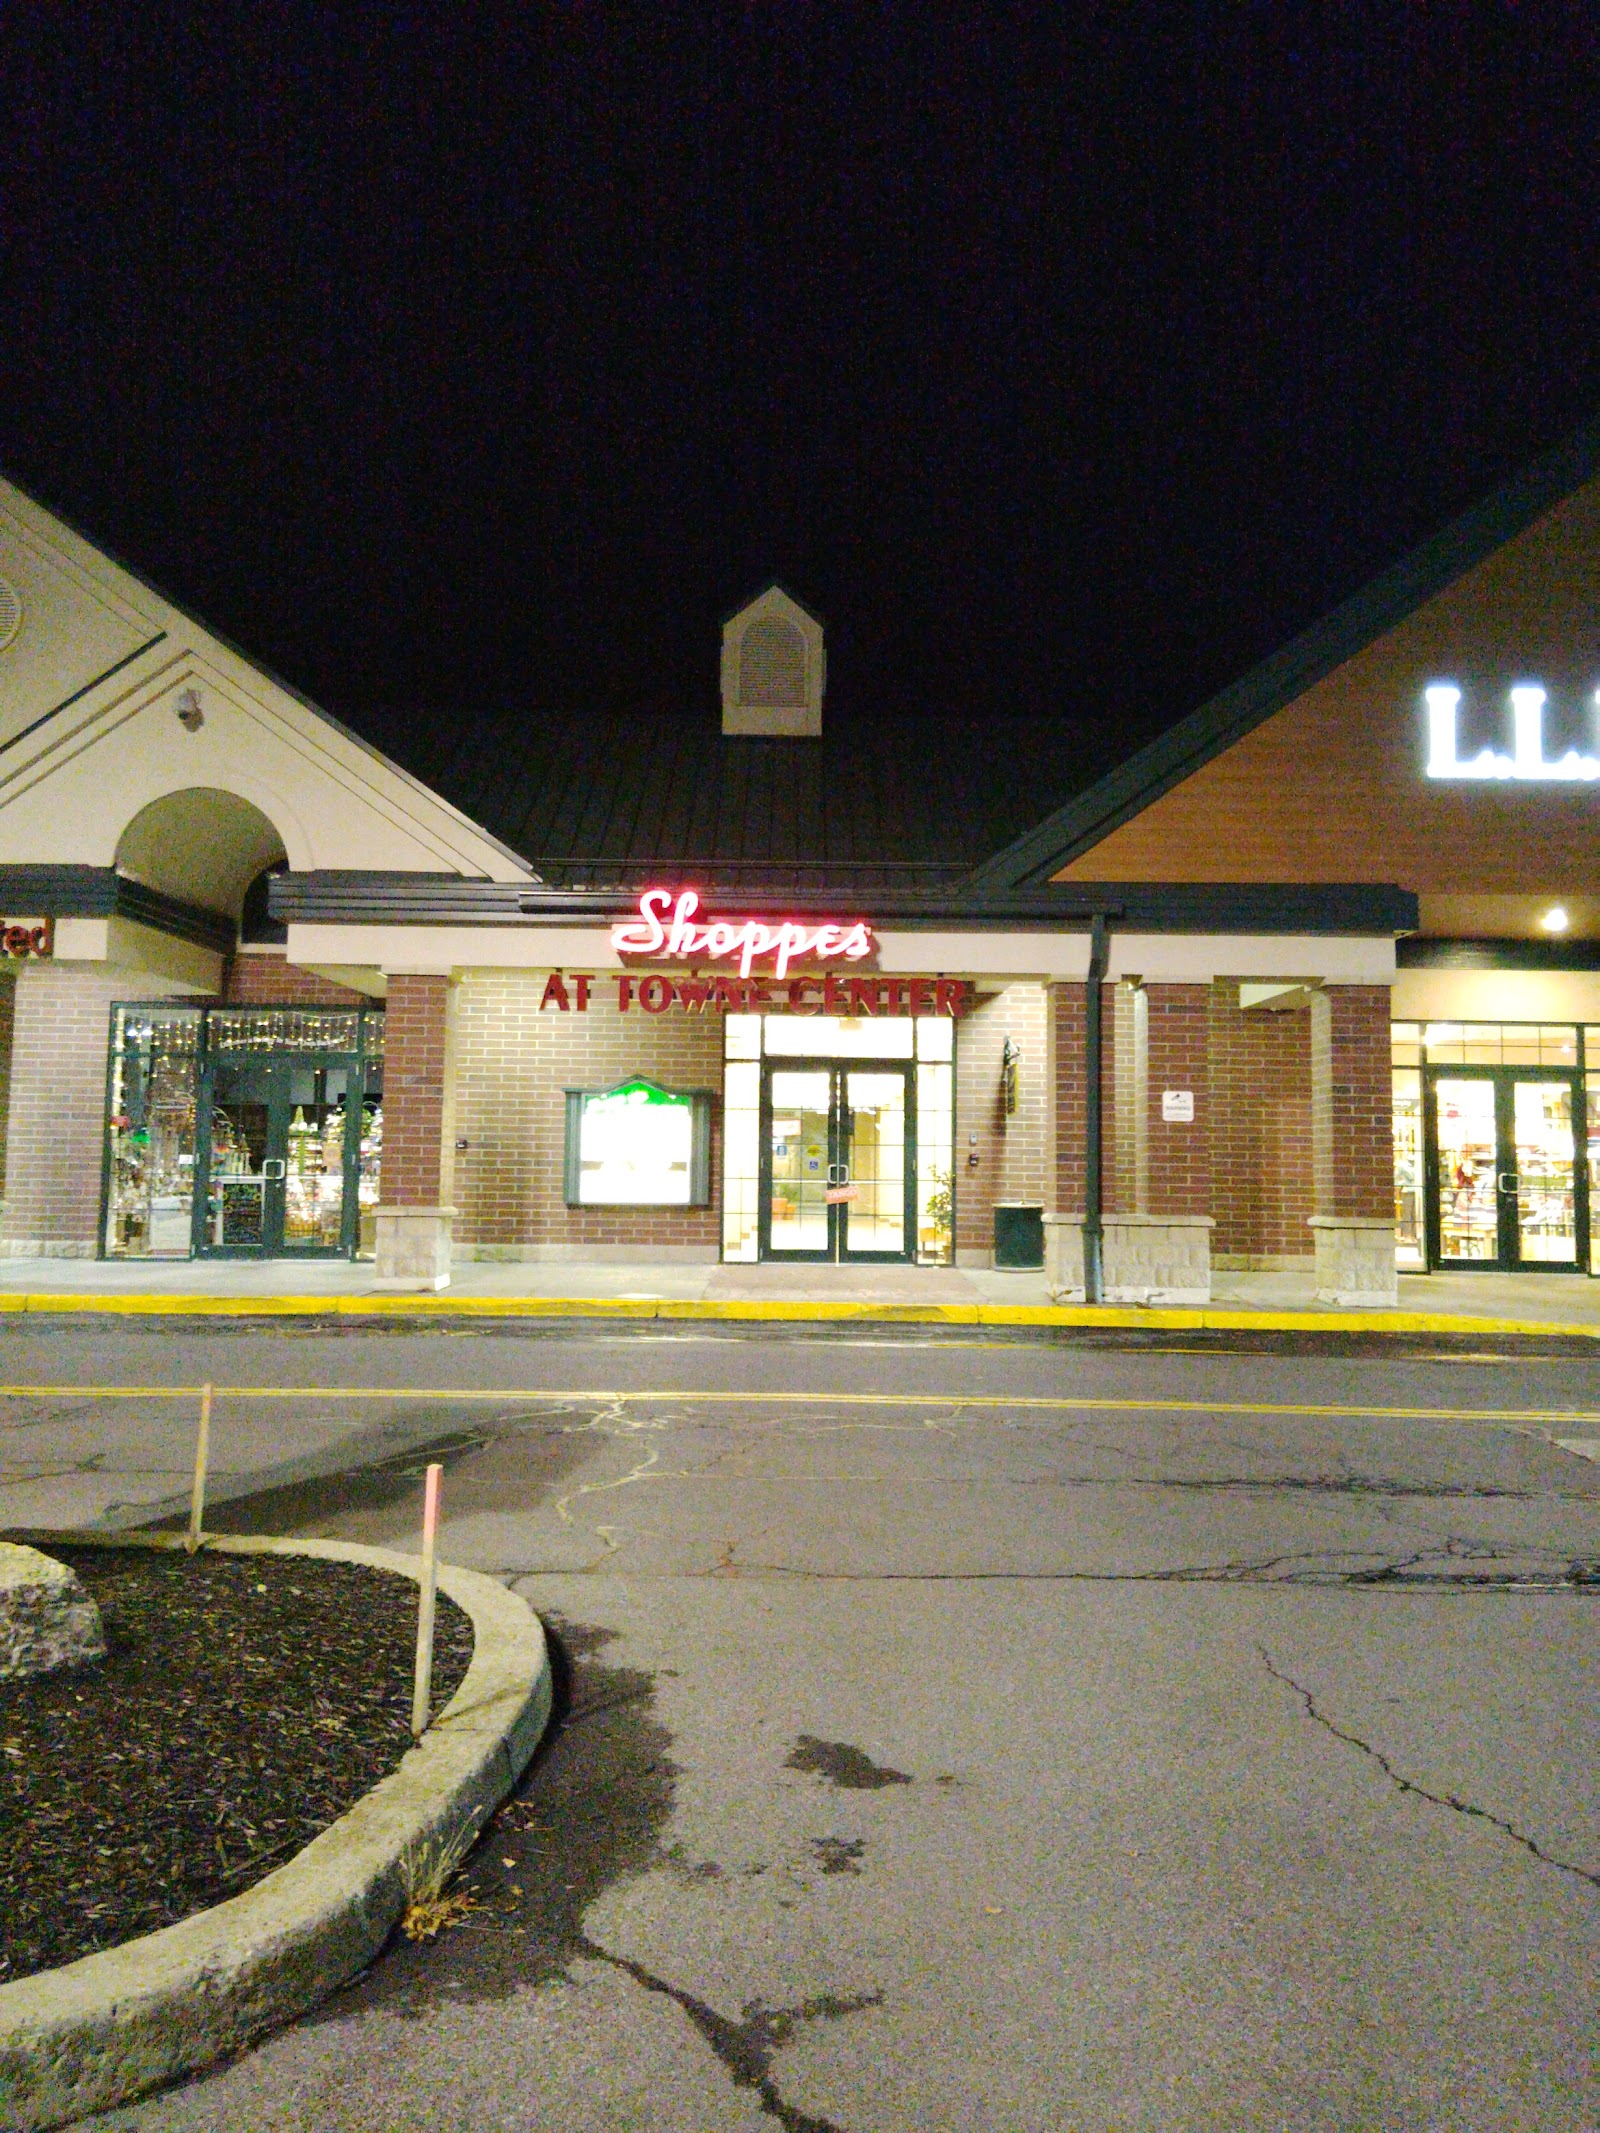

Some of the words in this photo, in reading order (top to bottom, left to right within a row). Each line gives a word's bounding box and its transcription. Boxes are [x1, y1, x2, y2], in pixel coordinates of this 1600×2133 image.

[1426, 687, 1600, 780] L.L.
[611, 890, 871, 980] Shoppes
[539, 974, 596, 1012] AT
[612, 974, 772, 1015] TOWNE
[788, 976, 966, 1018] CENTER
